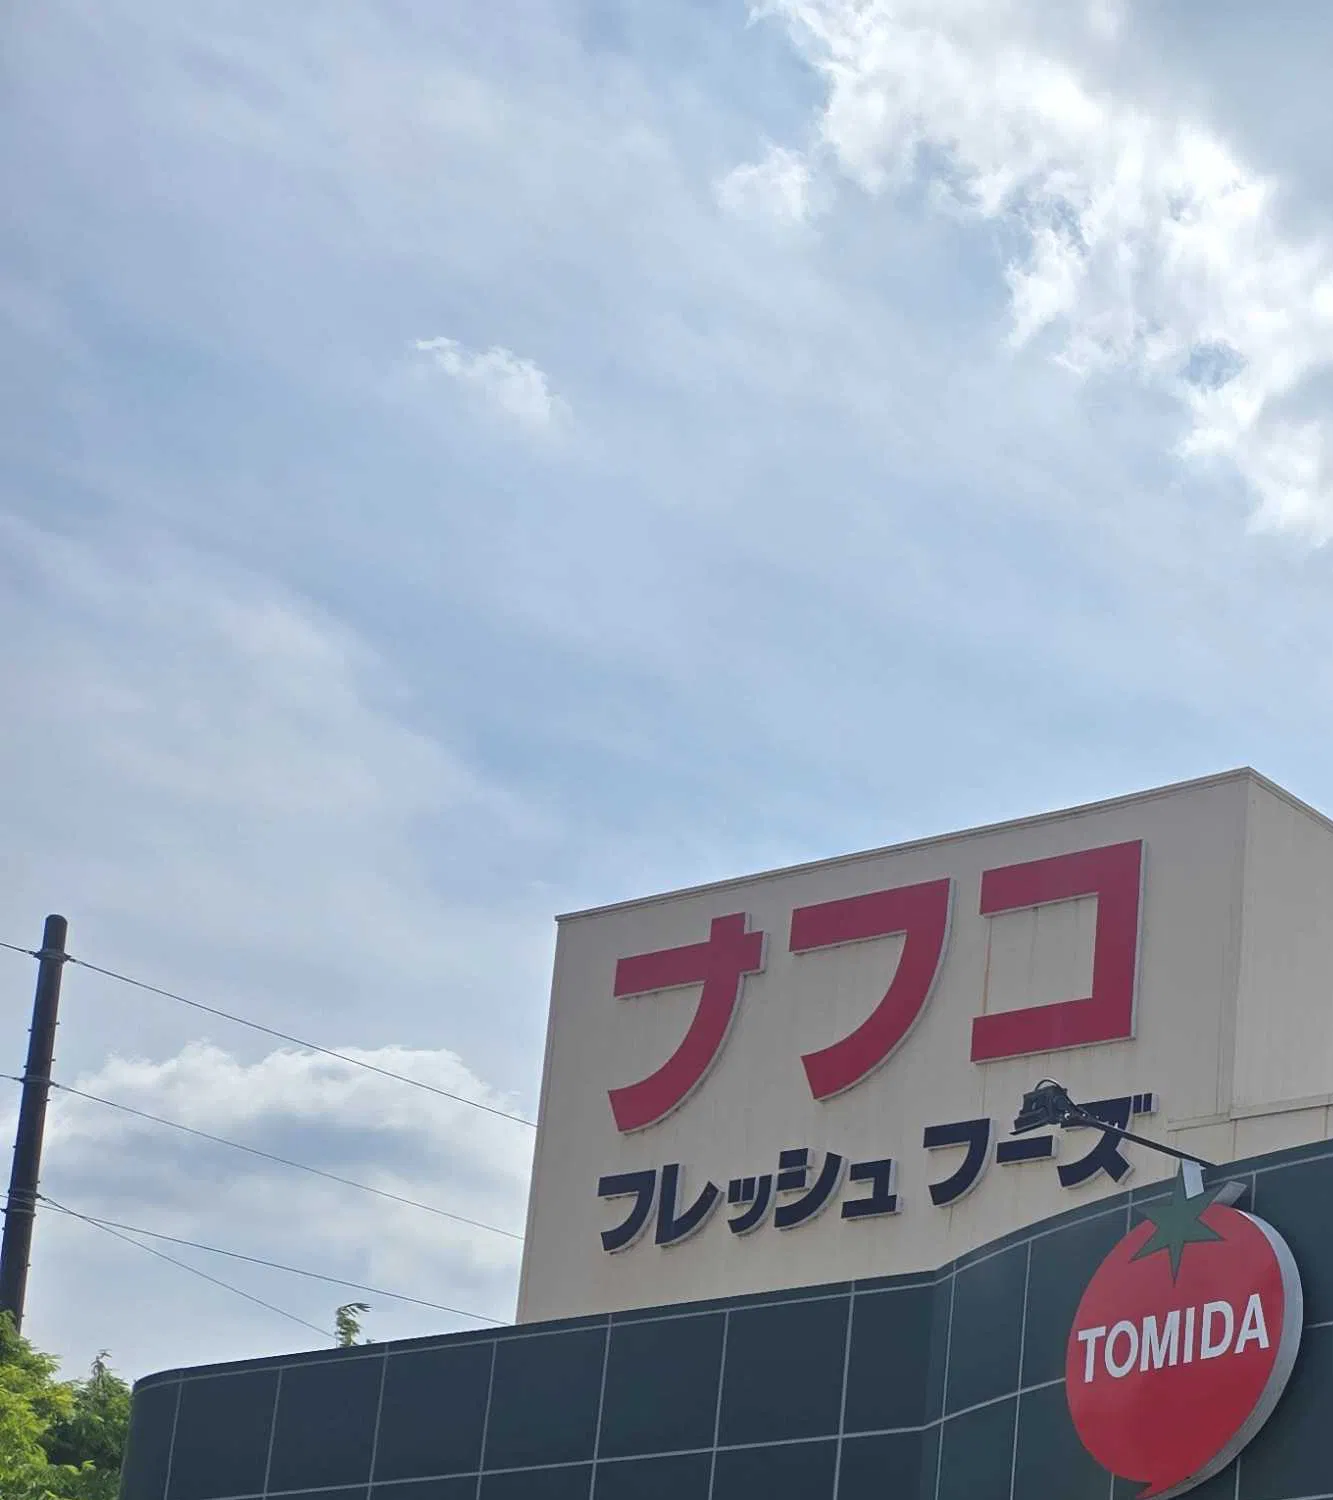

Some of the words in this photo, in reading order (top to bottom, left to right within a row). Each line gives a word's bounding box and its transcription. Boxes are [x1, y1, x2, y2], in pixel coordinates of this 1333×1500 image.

[608, 839, 1147, 1132] ナフコ
[598, 1146, 896, 1254] フレッシュ
[922, 1090, 1157, 1206] フーズ
[1077, 1291, 1270, 1383] TOMIDA
